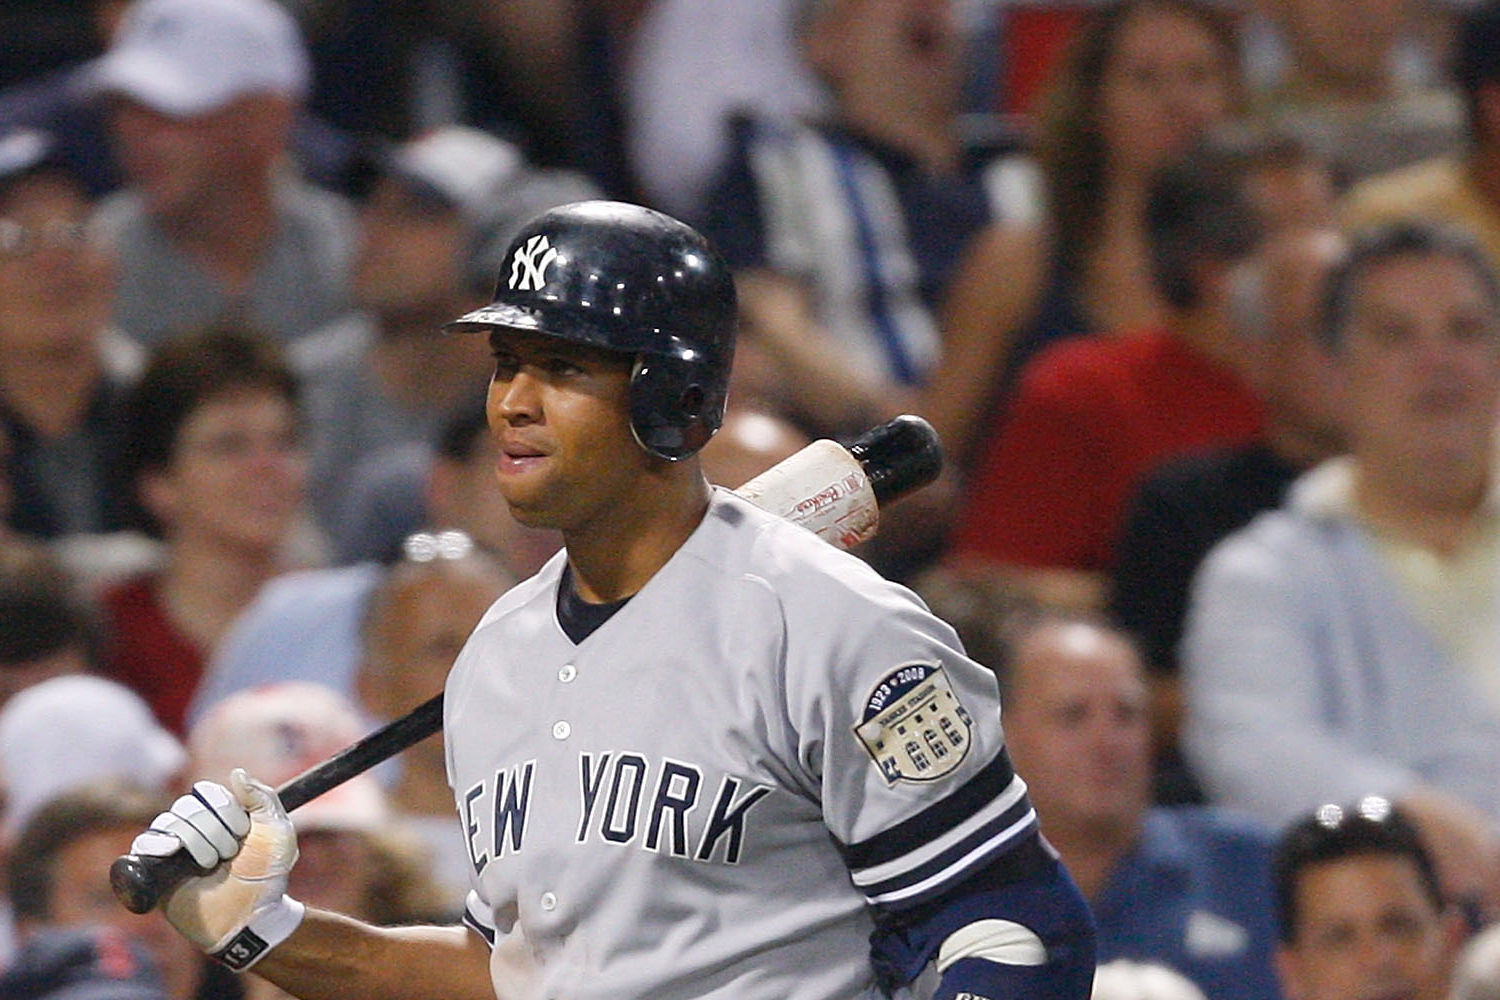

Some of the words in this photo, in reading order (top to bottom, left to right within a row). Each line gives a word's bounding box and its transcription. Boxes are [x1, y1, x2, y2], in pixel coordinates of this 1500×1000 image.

[869, 684, 892, 710] 1923
[897, 667, 925, 684] 2008
[457, 759, 537, 878] EW
[575, 750, 776, 864] YORK
[224, 943, 250, 965] 13
